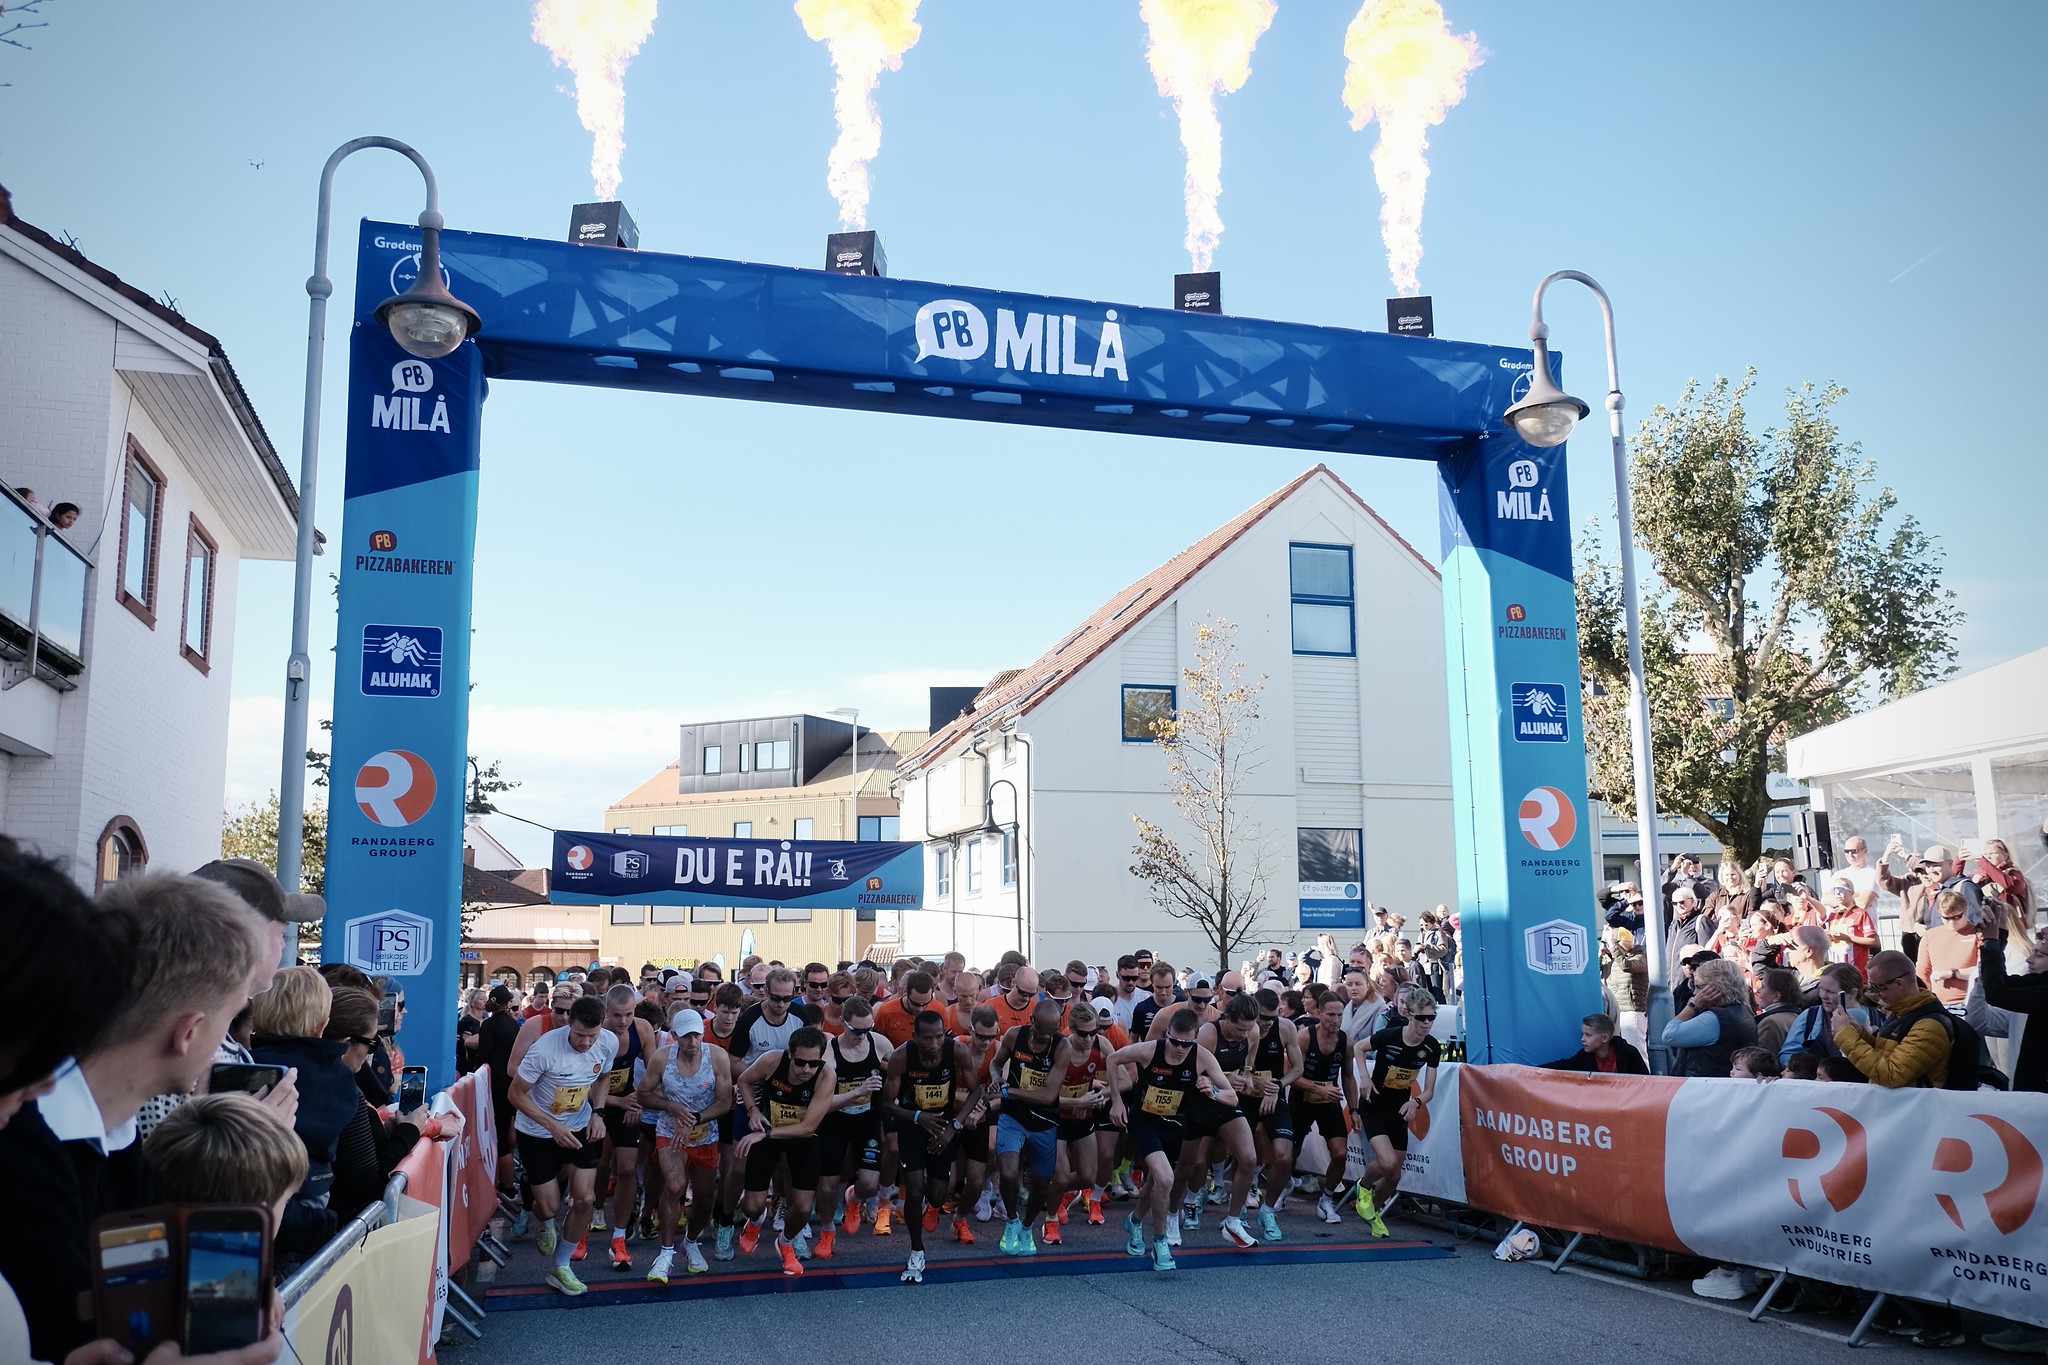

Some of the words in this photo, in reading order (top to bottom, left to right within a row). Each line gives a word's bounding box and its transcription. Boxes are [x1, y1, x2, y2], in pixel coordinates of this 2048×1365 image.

[374, 236, 423, 252] Grødem
[932, 310, 974, 350] PB
[994, 309, 1129, 382] MILÅ
[402, 364, 424, 387] PB
[371, 394, 451, 434] MILÅ
[1515, 464, 1533, 483] PB
[1497, 488, 1554, 522] MILÅ
[375, 533, 392, 548] PB
[356, 555, 453, 576] PIZZABAKEREN
[1498, 625, 1567, 641] PIZZABAKEREN
[370, 671, 432, 688] ALUHAK
[1520, 721, 1563, 735] ALUHAK
[351, 837, 435, 847] RANDABERG
[369, 848, 417, 858] GROUP
[674, 847, 716, 885] DU
[726, 849, 744, 886] E
[755, 841, 813, 887] RÅ!!
[1521, 859, 1580, 867] RANDABERG
[858, 893, 917, 905] PIZZABAKEREN
[376, 929, 411, 952] PS
[1547, 936, 1572, 955] PS
[374, 961, 408, 971] UTLEIE
[375, 952, 409, 961] selskaps
[925, 1090, 942, 1099] 1441
[1155, 1095, 1172, 1104] 1155
[1476, 1107, 1612, 1149] RANDABERG
[1501, 1143, 1577, 1177] GROUP
[1781, 1224, 1872, 1248] RANDABERG
[1789, 1238, 1872, 1266] INDUSTRIES
[1930, 1247, 2048, 1276] RANDABERG
[1953, 1265, 2031, 1291] COATING
